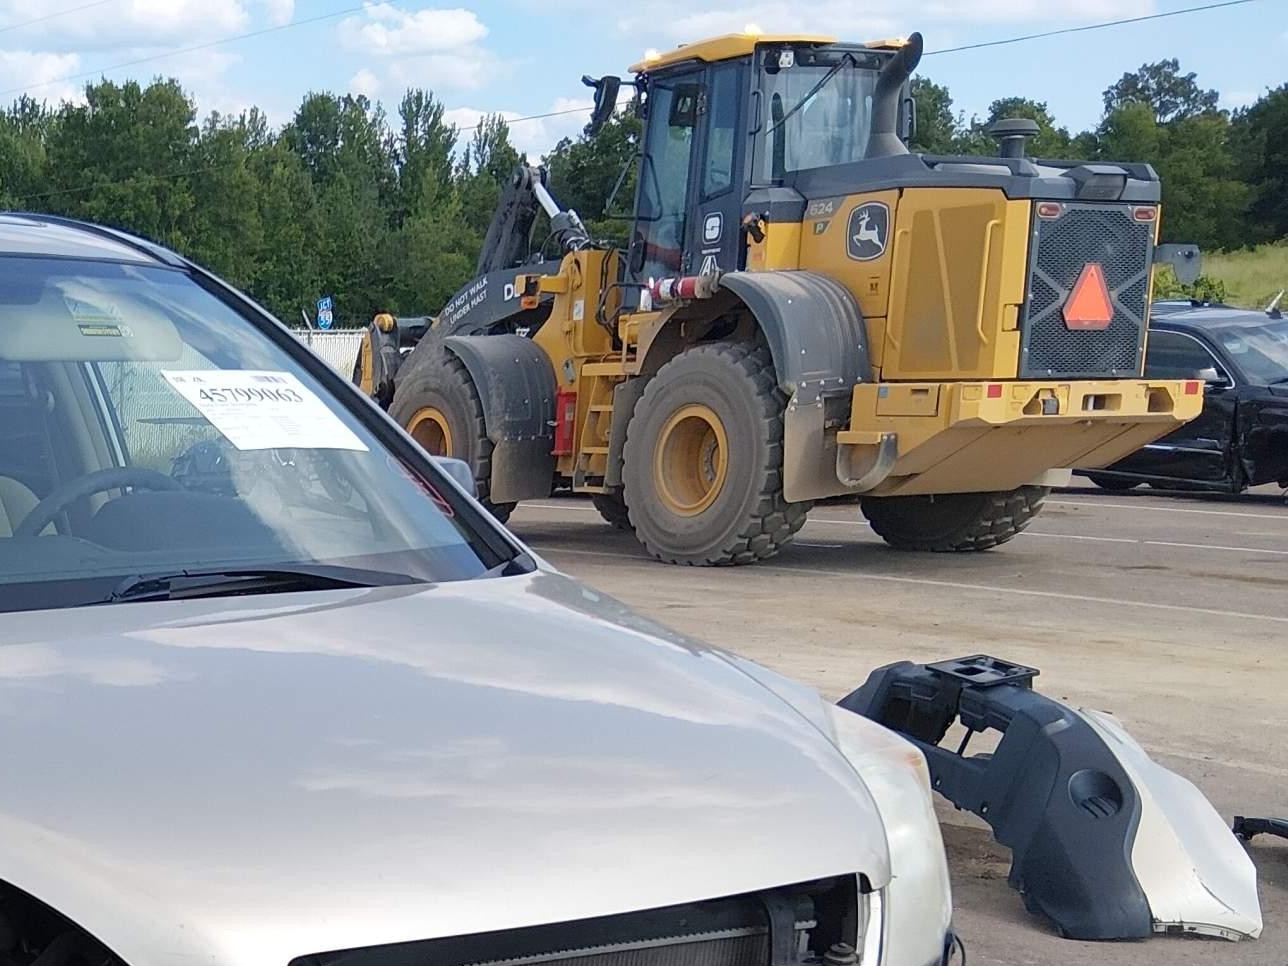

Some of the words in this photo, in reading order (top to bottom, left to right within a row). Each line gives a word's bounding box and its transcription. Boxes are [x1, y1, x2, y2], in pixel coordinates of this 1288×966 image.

[318, 298, 331, 310] JCT
[444, 303, 455, 316] DO
[455, 291, 469, 309] NOT
[469, 276, 489, 296] WALK
[450, 304, 472, 325] UNDER
[472, 289, 488, 308] MAST
[320, 314, 330, 326] 55
[198, 387, 304, 403] 45799063
